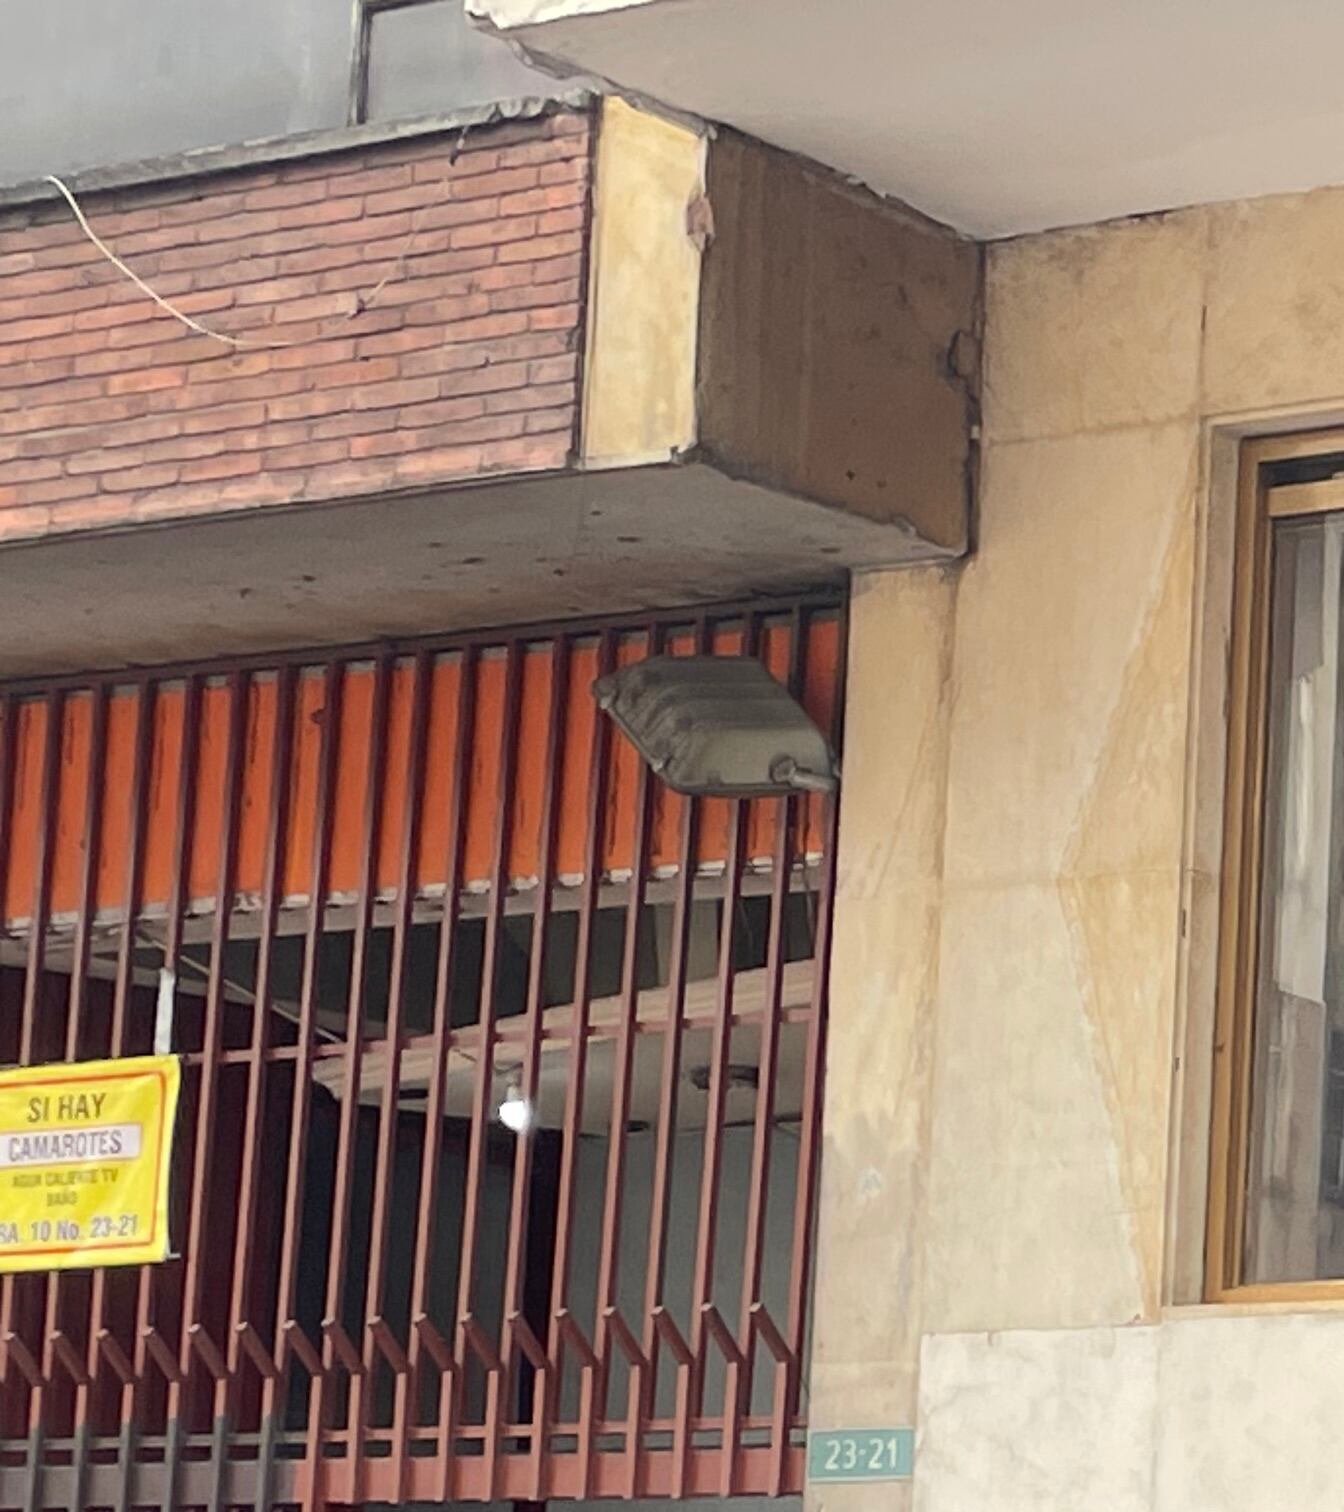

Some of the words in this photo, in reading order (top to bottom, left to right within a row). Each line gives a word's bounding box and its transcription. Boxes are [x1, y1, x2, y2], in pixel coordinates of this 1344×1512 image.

[27, 1097, 50, 1123] SI
[58, 1093, 107, 1121] HAY
[9, 1130, 122, 1162] CAMAROTES
[90, 1214, 139, 1238] 23-21
